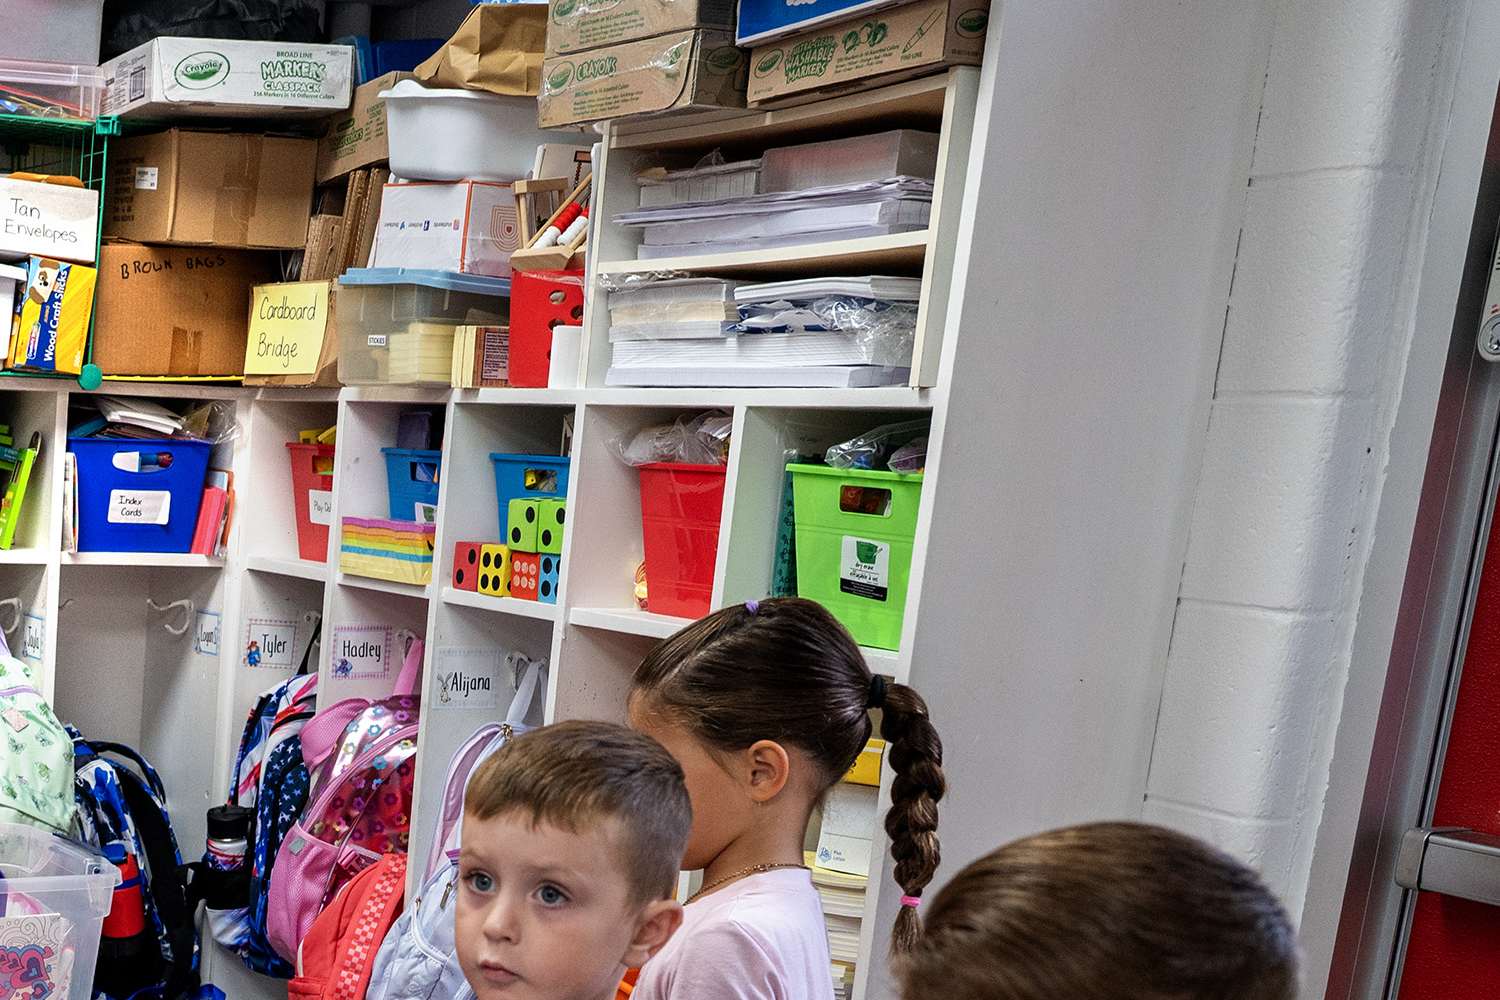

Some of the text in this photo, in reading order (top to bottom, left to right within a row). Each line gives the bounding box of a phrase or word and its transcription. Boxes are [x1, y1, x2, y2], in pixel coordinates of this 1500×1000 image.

[184, 60, 219, 74] Crayola
[261, 60, 326, 82] MARKERS
[576, 56, 617, 82] CRAYONS
[785, 46, 836, 71] WASHABLE
[786, 62, 827, 84] MARKERS
[263, 81, 321, 93] CLASSPACK
[10, 197, 41, 219] Tan
[4, 218, 77, 243] Envelopes
[121, 254, 226, 279] BROWN BAGS
[43, 270, 68, 361] Wood Craft Sticks
[259, 294, 317, 320] Cardboard
[257, 332, 298, 368] Bridge
[118, 495, 142, 505] Index
[120, 507, 142, 517] Cards
[262, 633, 287, 658] Tyler
[342, 640, 381, 662] Hadley
[450, 672, 490, 697] Alijana
